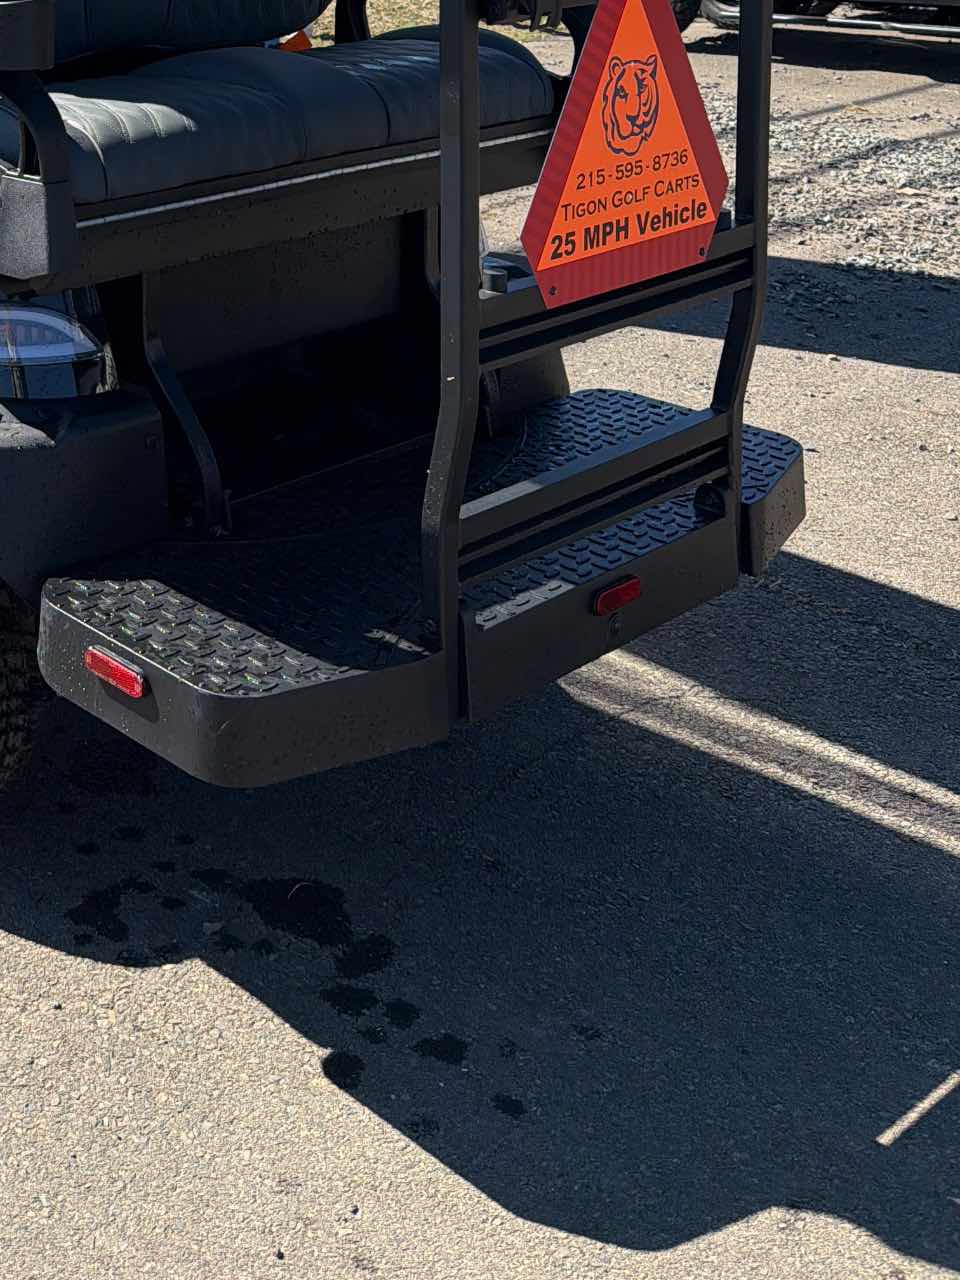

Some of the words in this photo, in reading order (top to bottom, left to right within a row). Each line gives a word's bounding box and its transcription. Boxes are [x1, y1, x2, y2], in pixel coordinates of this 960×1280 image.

[576, 149, 689, 190] 215-595-8736
[561, 197, 608, 222] TIGON
[611, 186, 651, 209] GOLF
[653, 173, 700, 198] CARTS
[550, 233, 577, 261] 25
[583, 216, 630, 252] MPH
[635, 199, 708, 236] Vehicle
